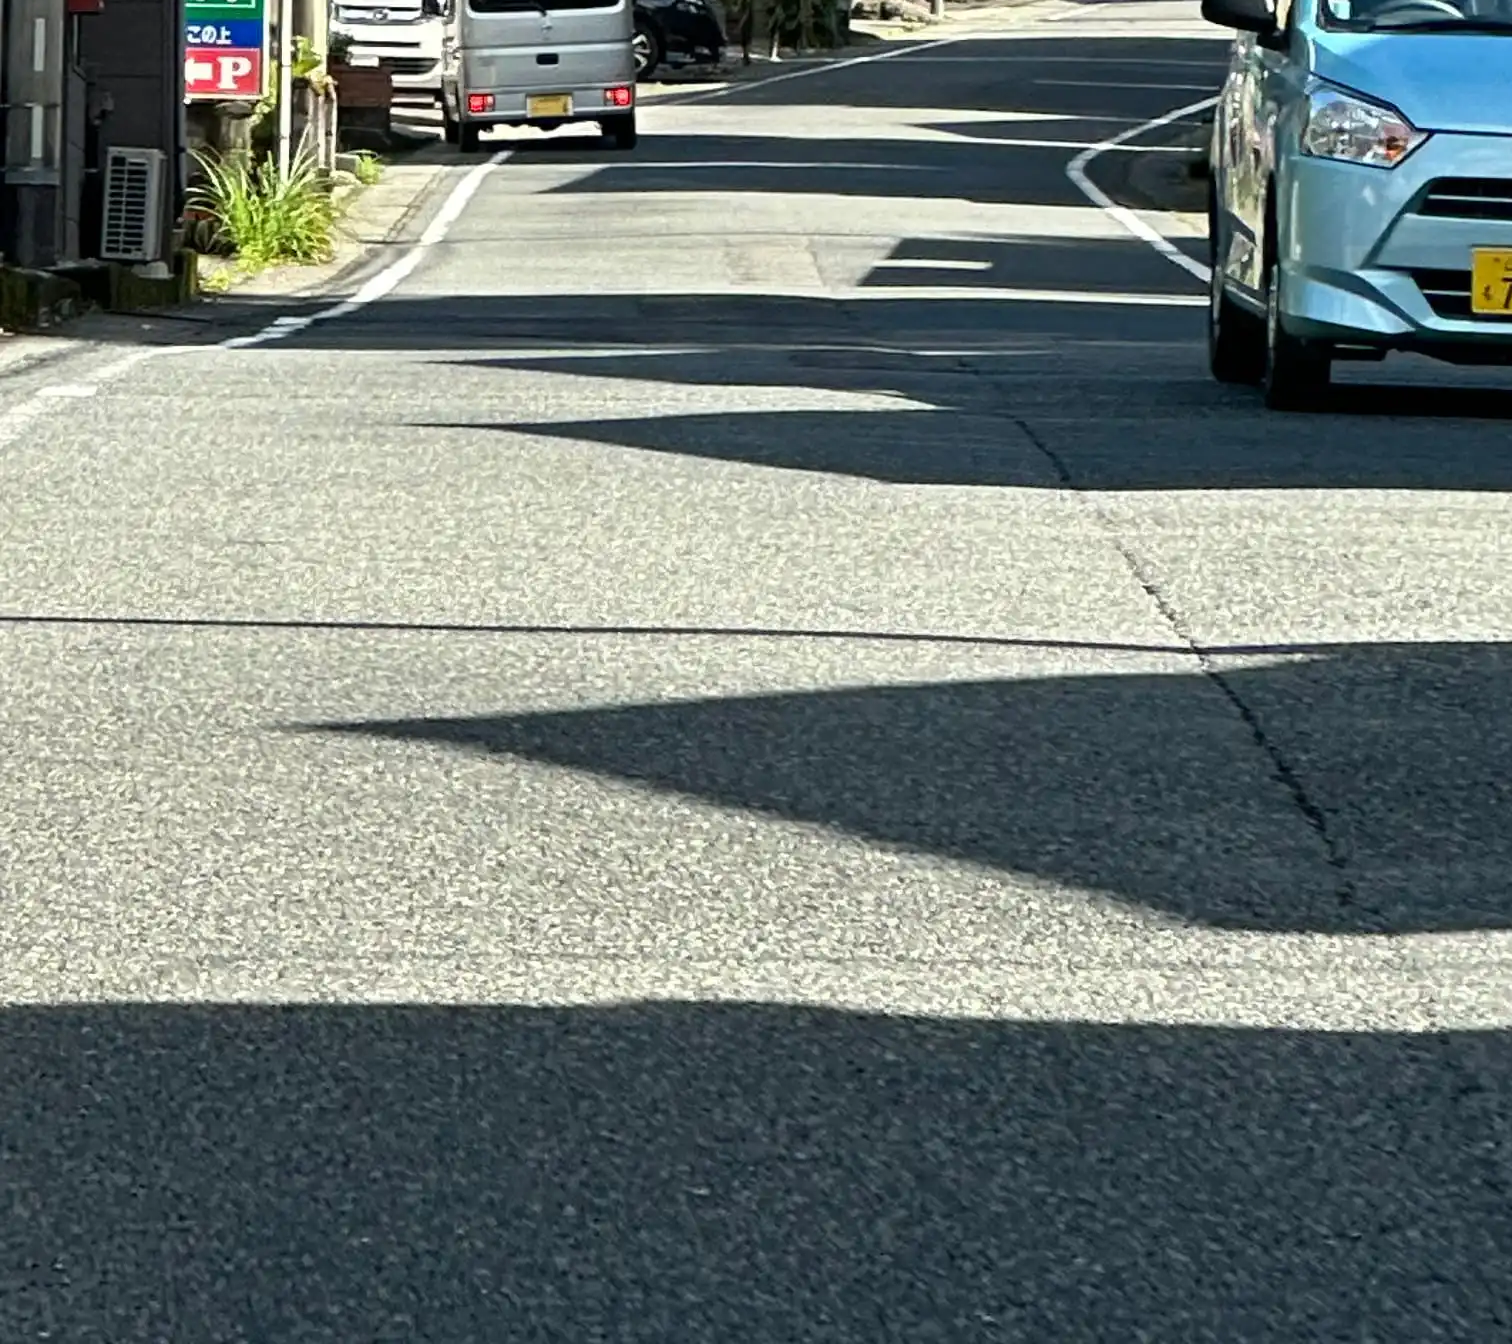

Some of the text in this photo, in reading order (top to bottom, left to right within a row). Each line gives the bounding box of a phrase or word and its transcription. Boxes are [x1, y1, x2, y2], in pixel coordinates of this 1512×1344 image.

[187, 25, 232, 44] この上
[217, 56, 252, 90] P
